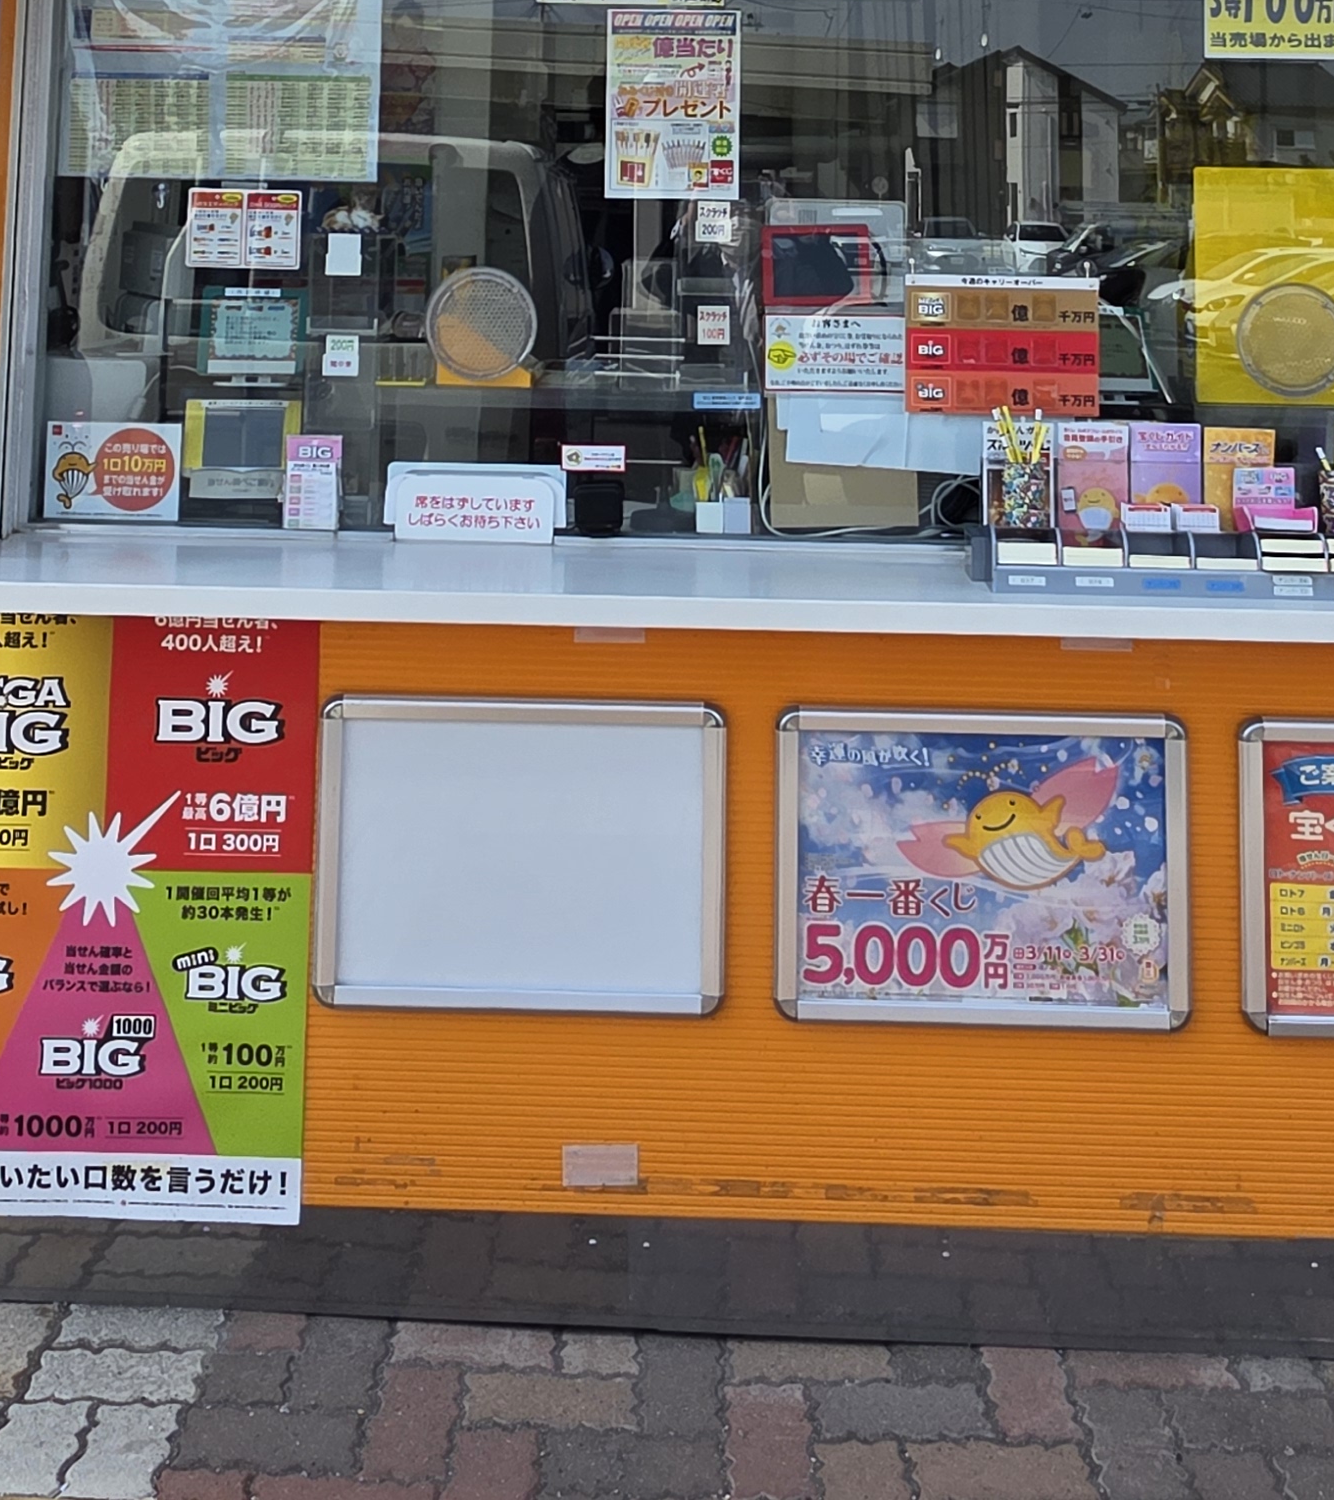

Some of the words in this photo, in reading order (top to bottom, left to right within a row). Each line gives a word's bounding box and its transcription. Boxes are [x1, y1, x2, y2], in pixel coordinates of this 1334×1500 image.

[614, 14, 643, 27] OPEN
[644, 14, 674, 27] OPEN
[674, 14, 704, 27] OPEN
[704, 14, 735, 27] OPEN
[642, 97, 732, 119] プレゼント
[699, 206, 728, 218] スクラッチ
[701, 224, 725, 236] 200円
[699, 311, 728, 322] スクラッチ
[918, 304, 944, 315] BIG
[1058, 310, 1095, 323] 千万円
[701, 328, 726, 340] 100円
[917, 344, 944, 356] BIG
[1058, 353, 1095, 366] 千万円
[917, 387, 944, 398] BIG
[1058, 395, 1095, 407] 千万円
[104, 443, 167, 454] この売り場では
[298, 445, 332, 459] BIG
[103, 455, 167, 473] 1口10万円
[415, 495, 535, 512] 席をはずしています
[407, 513, 541, 530] しばらくお待ち下さい
[161, 634, 262, 653] 400人超え!
[155, 699, 283, 745] BIG
[195, 747, 242, 763] ビッグ
[209, 792, 287, 822] 6億円
[187, 833, 216, 851] 1口
[222, 833, 280, 853] 300円
[166, 885, 292, 902] 1開催回平均1等が
[804, 874, 977, 918] 春一番くじ
[1279, 888, 1305, 899] ロト7
[181, 904, 273, 921] 約30本発生!
[1280, 906, 1306, 916] ロト6
[1280, 923, 1305, 933] ミニロト
[65, 945, 133, 959] 当せん確率と
[802, 923, 981, 987] 5,000
[983, 932, 1011, 990] 万円
[1025, 945, 1062, 962] 3/11
[1079, 946, 1115, 962] 3/31
[174, 948, 217, 971] mini
[64, 962, 133, 976] 当せん金額の
[42, 979, 151, 993] バランスで選ぶなら!
[184, 964, 286, 1002] BIG
[207, 1002, 259, 1014] ミニビッグ
[114, 1016, 153, 1036] 1000
[39, 1038, 145, 1077] BIG
[222, 1044, 273, 1067] 100
[56, 1078, 124, 1090] ビッグ1000
[208, 1076, 231, 1090] 1口
[237, 1076, 283, 1091] 200円
[13, 1115, 83, 1138] 1000
[137, 1120, 183, 1136] 200円
